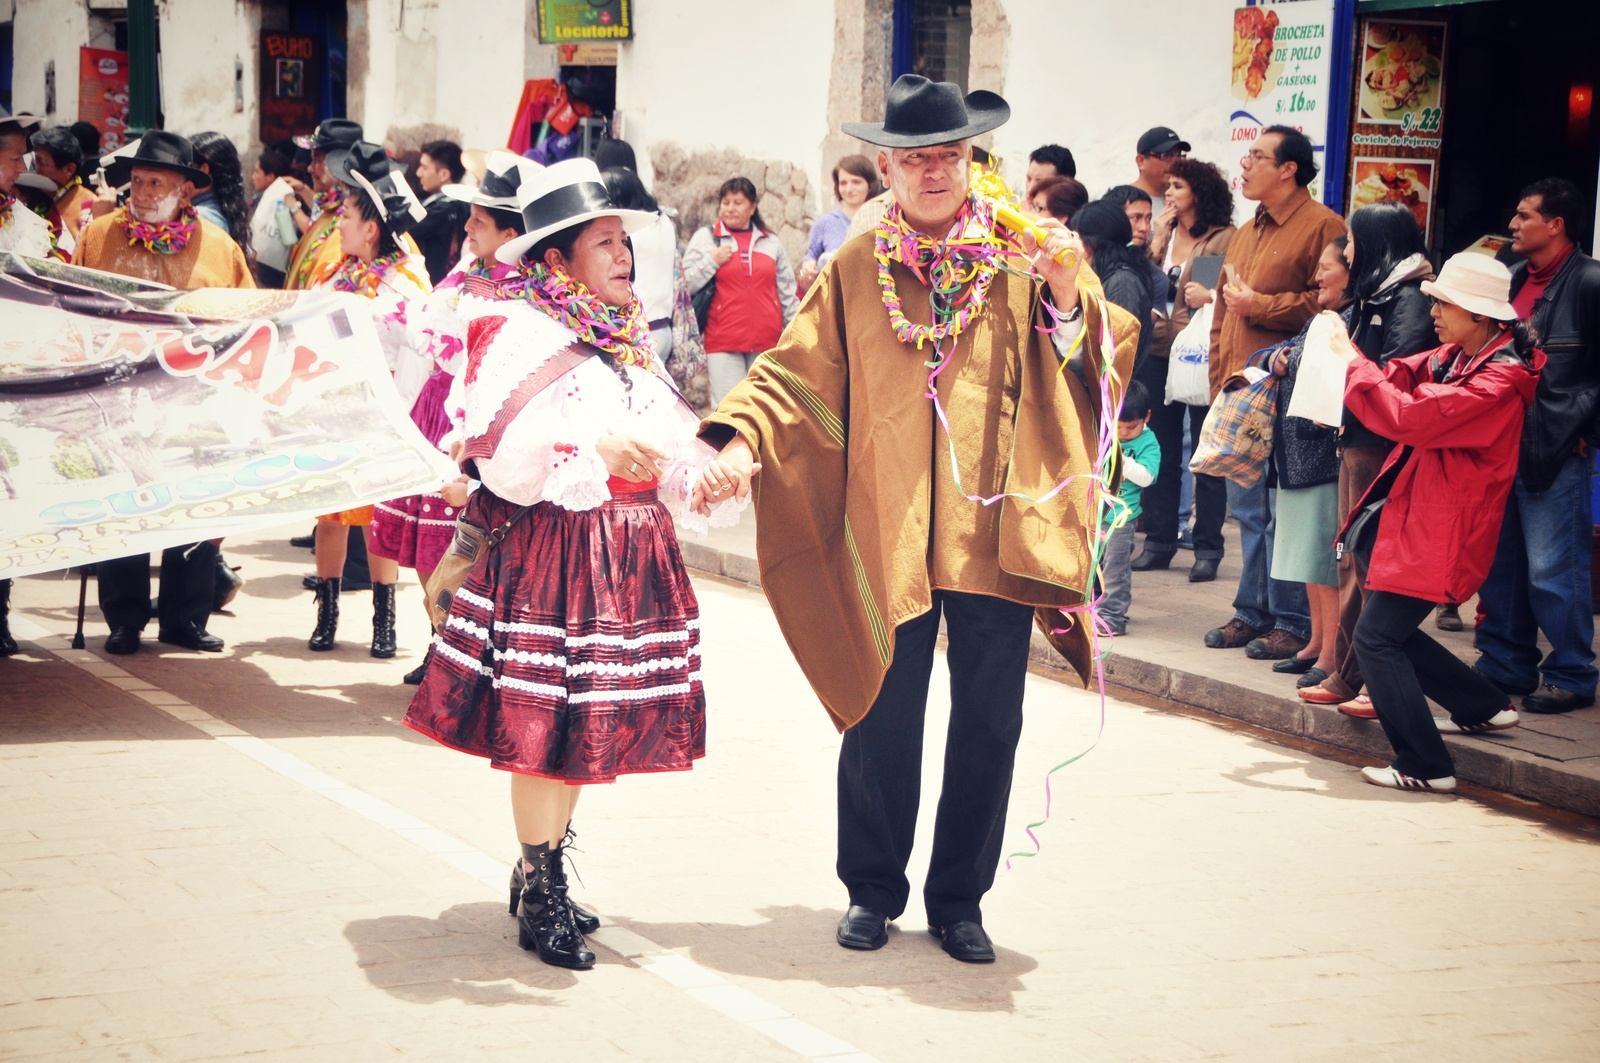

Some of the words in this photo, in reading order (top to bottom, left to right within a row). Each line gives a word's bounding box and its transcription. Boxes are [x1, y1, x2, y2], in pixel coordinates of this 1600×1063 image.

[555, 24, 629, 38] Locutorio
[1274, 24, 1325, 41] BROCHETA
[1274, 48, 1287, 61] DE
[1290, 46, 1321, 61] POLLO
[1276, 75, 1317, 86] GASEOSA
[1418, 107, 1441, 131] 22
[1231, 127, 1257, 141] LOMO
[1353, 135, 1387, 145] Ceviche
[1390, 135, 1402, 145] de
[1403, 136, 1441, 148] Pejerrey
[39, 445, 360, 526] CUSCO
